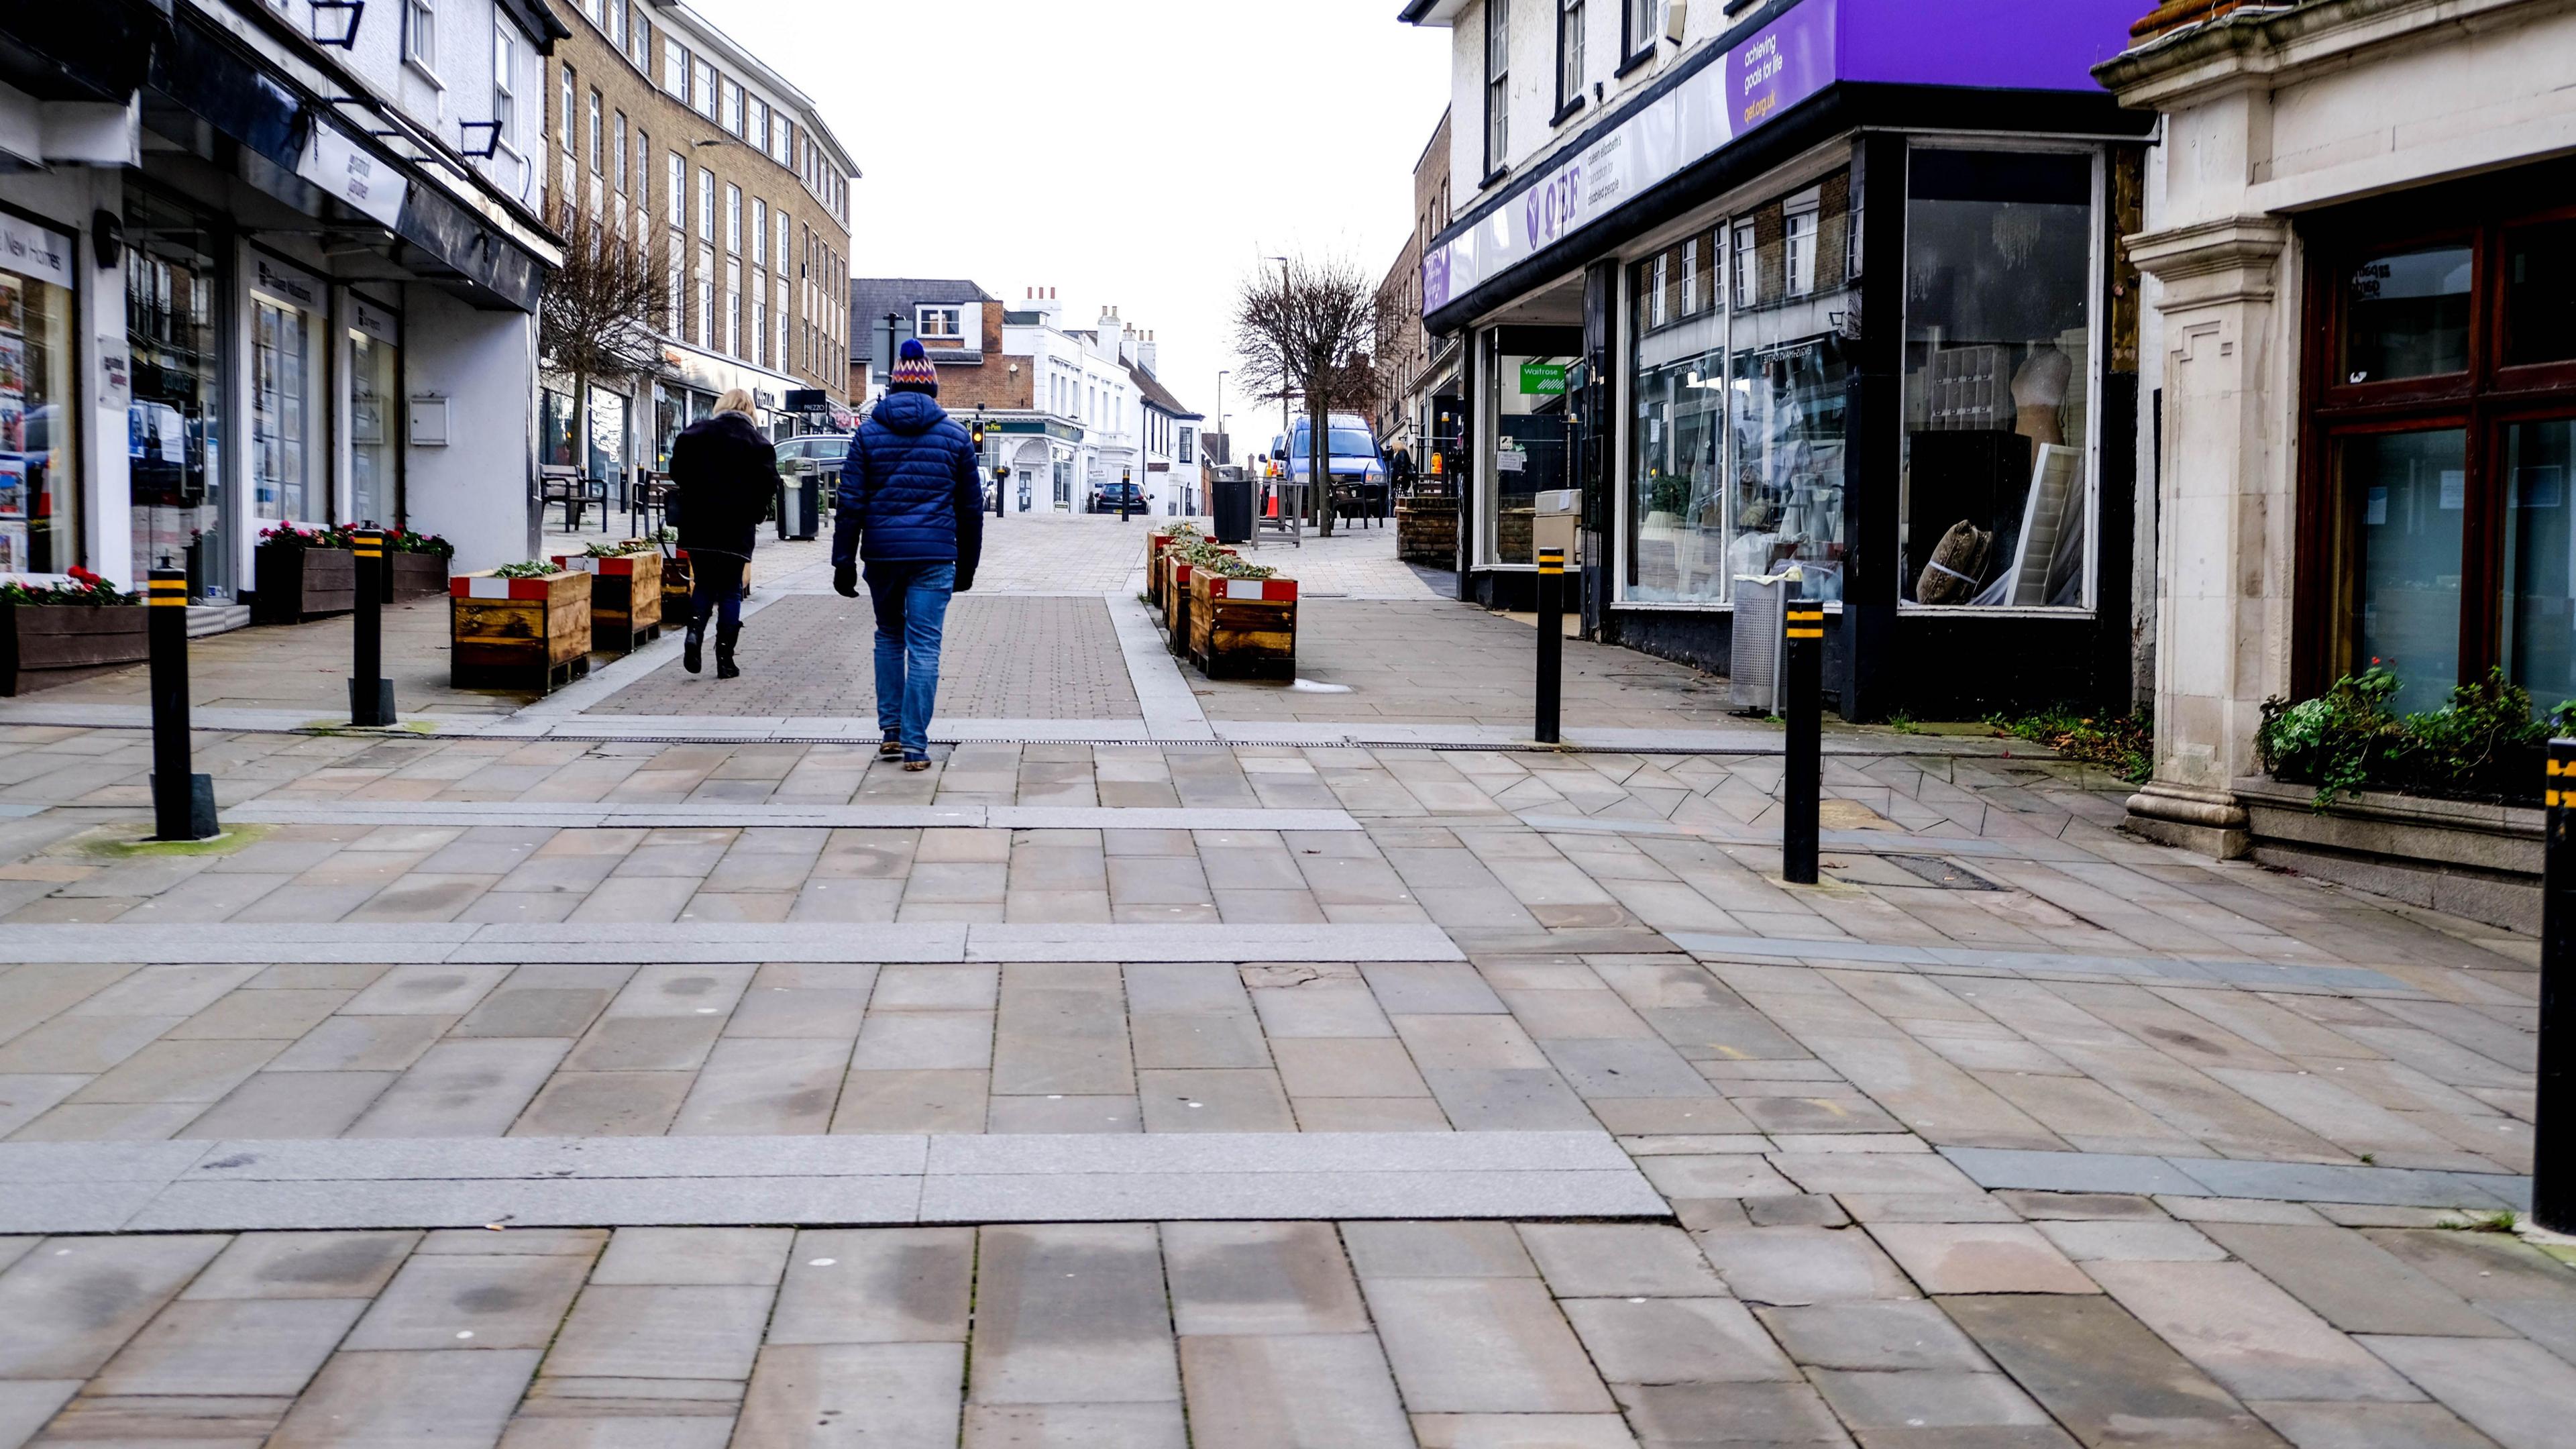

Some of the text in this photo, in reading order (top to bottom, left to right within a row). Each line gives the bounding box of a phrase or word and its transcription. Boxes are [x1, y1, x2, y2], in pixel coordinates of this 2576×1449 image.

[1745, 34, 1776, 67] achieving
[1745, 52, 1782, 96] goals for life
[1744, 89, 1776, 124] qef.org.uk
[1587, 134, 1621, 166] queen elizabeth's
[1545, 166, 1580, 239] QEF
[1587, 177, 1619, 206] disabled people
[1524, 368, 1558, 376] Waitrose
